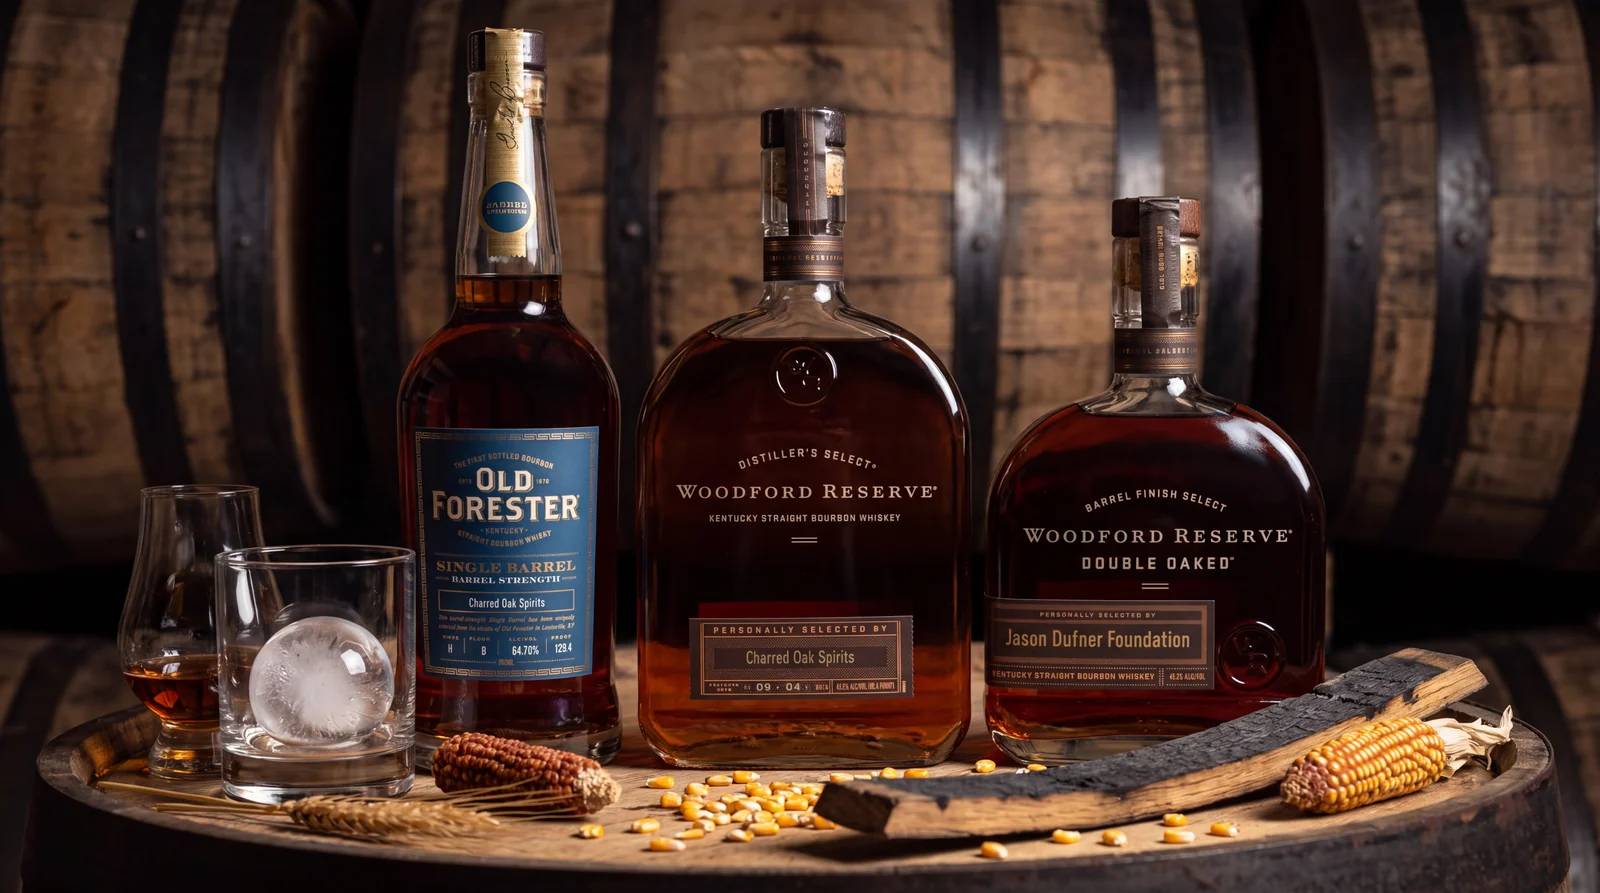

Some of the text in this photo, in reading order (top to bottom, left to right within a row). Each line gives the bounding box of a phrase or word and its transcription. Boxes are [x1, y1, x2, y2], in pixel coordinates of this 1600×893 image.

[467, 454, 486, 465] FIRST
[487, 452, 520, 460] BOTTLED
[521, 454, 554, 470] BOURBON
[738, 448, 818, 470] DISTILLER'S
[476, 467, 534, 493] OLD
[676, 484, 813, 499] WOODFORD
[432, 490, 580, 522] FORESTER
[1085, 488, 1227, 513] BARREL FINISH SELECT
[709, 513, 901, 522] KENTUCKY STRAIGHT BOURBON WHISKEY
[457, 529, 489, 546] STRAIGHT
[490, 538, 525, 547] BOURBON
[1023, 528, 1164, 543] WOODFORD
[436, 560, 576, 574] SINGLE BARREL
[1082, 557, 1157, 570] DOUBLE
[452, 576, 496, 584] BARREL
[498, 575, 561, 584] STRENGTH
[468, 598, 545, 610] Charred Oak Spirits
[713, 626, 795, 634] PERSONALLY
[802, 625, 866, 633] SELECTED
[1005, 628, 1190, 648] Jason Dufner Foundation
[447, 643, 453, 654] H
[512, 645, 540, 656] 64.70%
[746, 650, 855, 667] Charred Oak Spirits
[1034, 671, 1075, 680] STRAIGHT
[1077, 672, 1116, 680] BOURBON
[1118, 672, 1155, 680] WHISKEY
[756, 682, 771, 691] 09
[785, 682, 801, 691] 04
